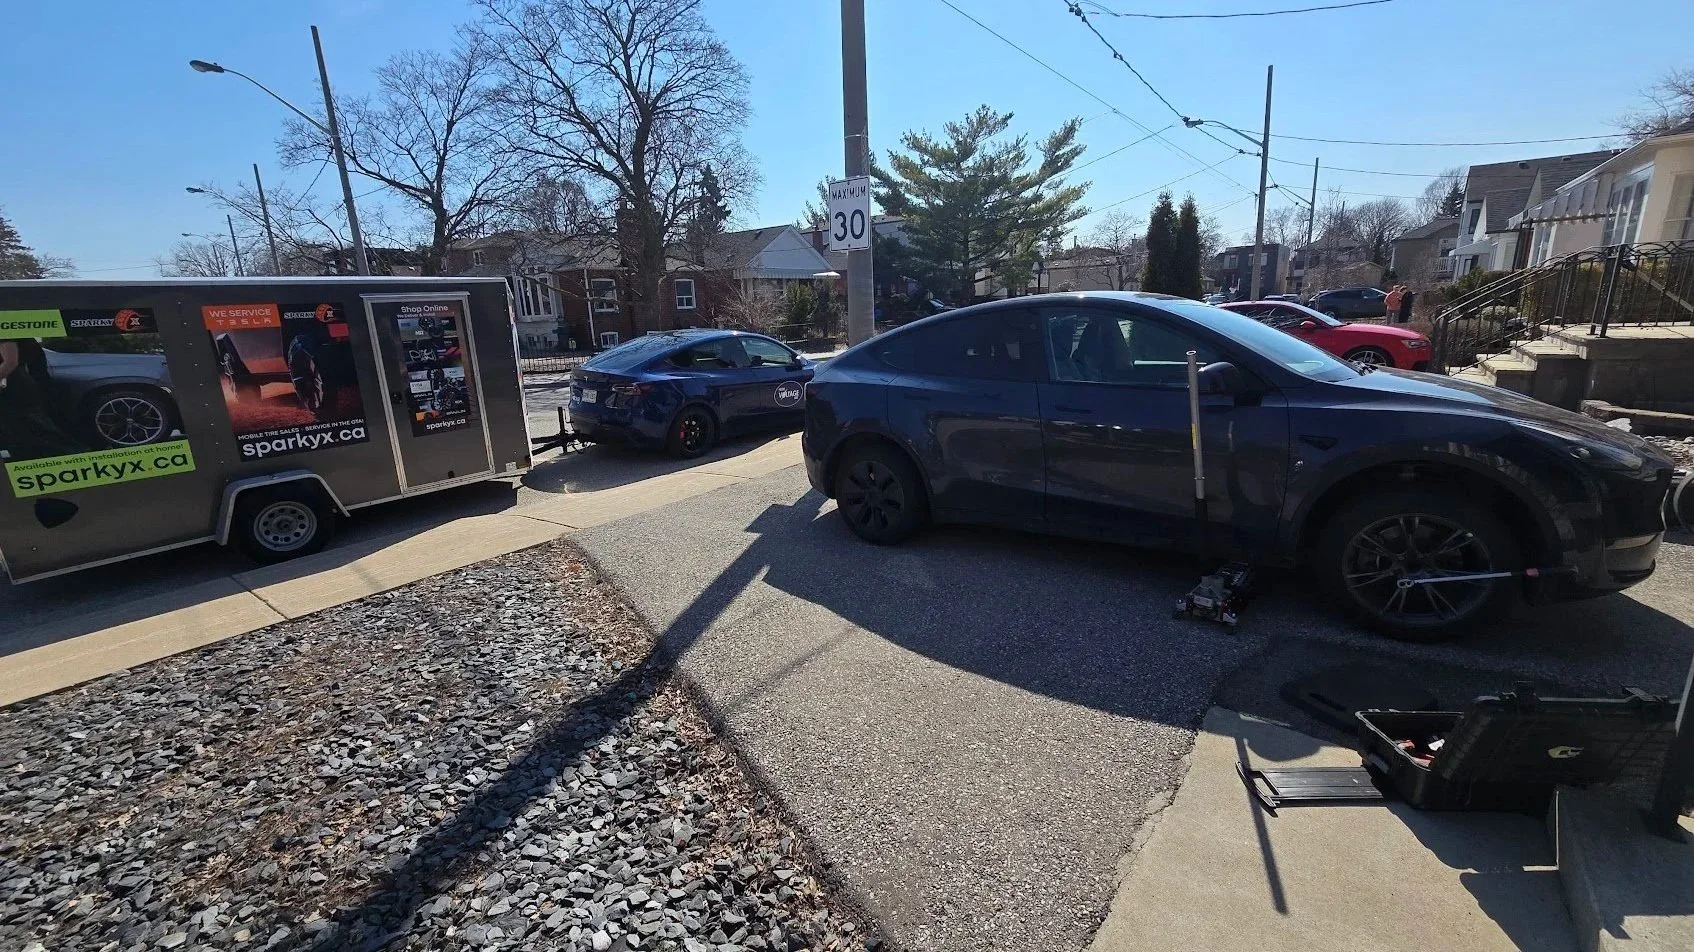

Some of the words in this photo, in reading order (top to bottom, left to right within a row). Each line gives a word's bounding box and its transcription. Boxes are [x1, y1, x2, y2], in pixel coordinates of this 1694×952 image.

[832, 186, 866, 201] MAXIMUM
[834, 209, 866, 242] 30
[209, 310, 227, 318] WE
[228, 308, 272, 317] SERVICE
[283, 311, 316, 319] SPARKY
[401, 305, 422, 314] Shop
[1, 320, 58, 330] GESTONE
[71, 318, 115, 328] SPARKY
[426, 418, 466, 430] sparkyxca
[238, 432, 264, 441] MOBILE
[279, 427, 300, 435] SALES
[305, 423, 331, 432] SERVICE
[242, 426, 366, 458] sparkyx.ca
[13, 459, 63, 472] Available
[64, 457, 87, 466] with
[88, 449, 143, 461] installation
[156, 443, 184, 453] home!
[17, 453, 188, 491] sparkyx.ca
